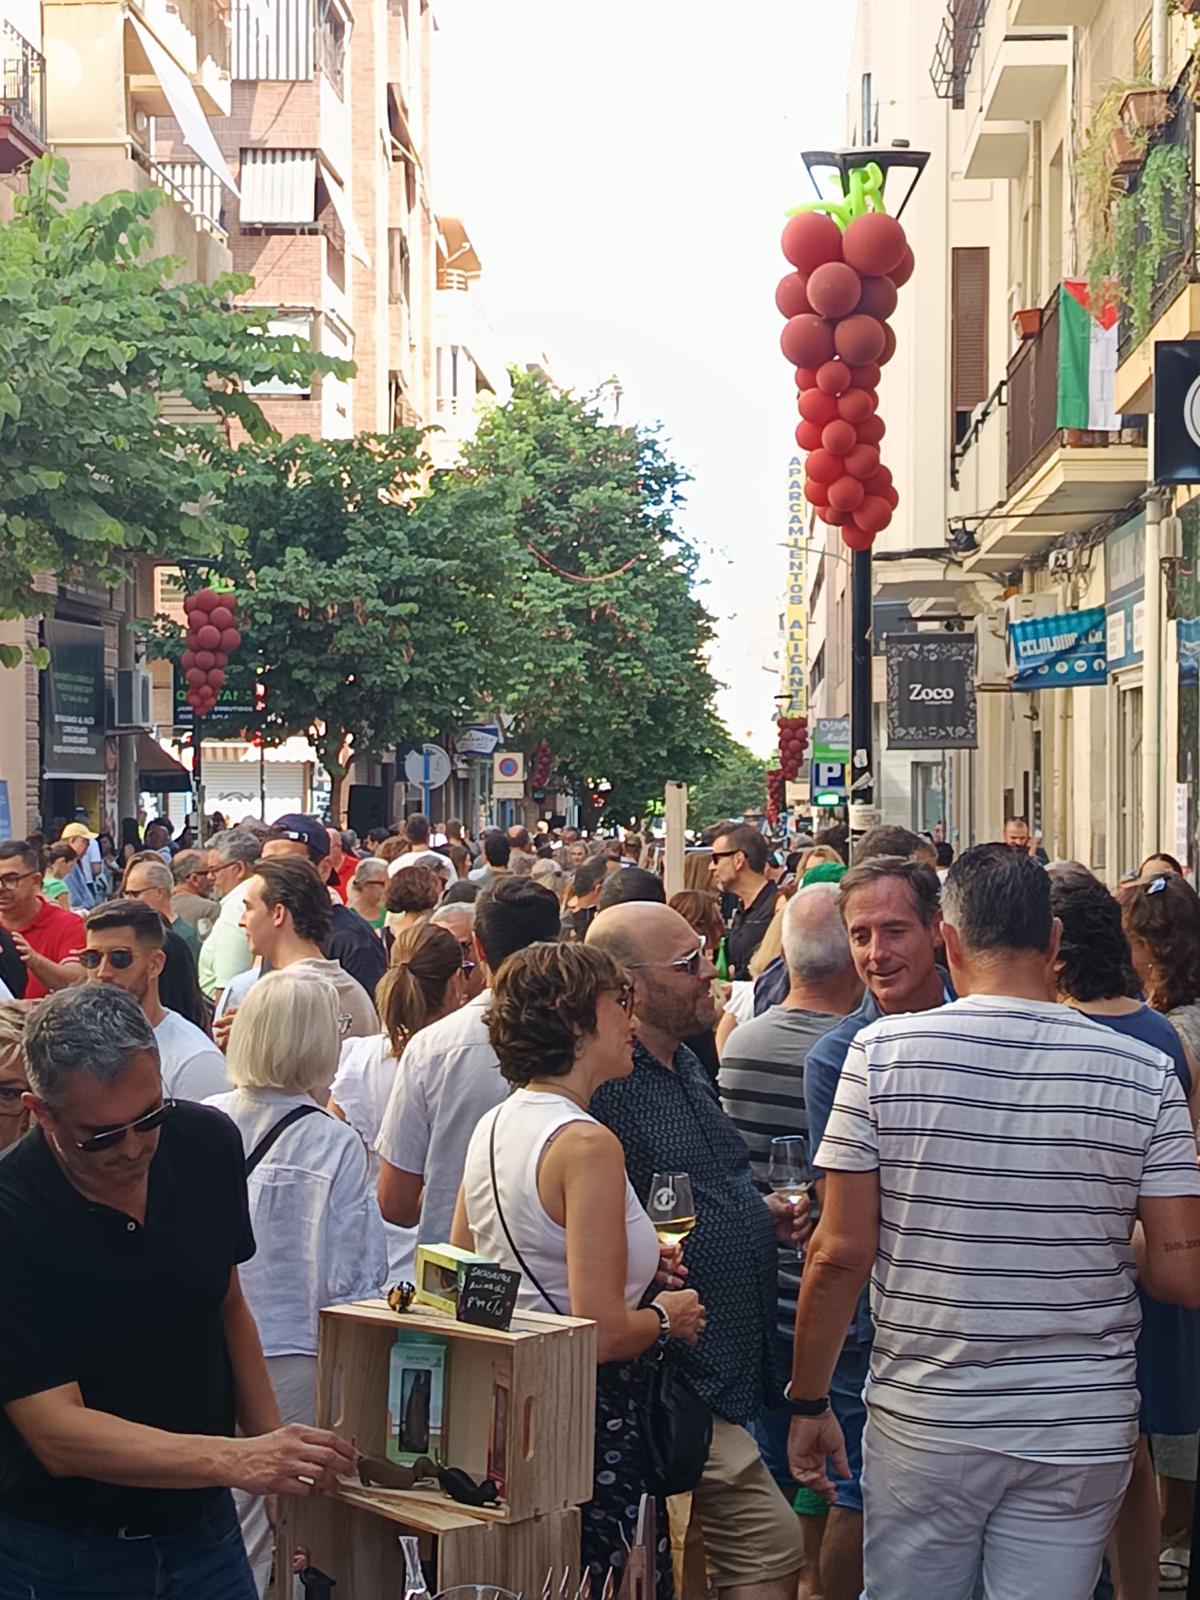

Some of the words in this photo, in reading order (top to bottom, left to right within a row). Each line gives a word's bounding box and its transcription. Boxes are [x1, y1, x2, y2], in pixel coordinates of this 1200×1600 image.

[788, 456, 804, 605] APARCAMIENTOS
[789, 620, 804, 711] ALICANTE
[908, 683, 955, 701] Zoco
[818, 763, 842, 787] P
